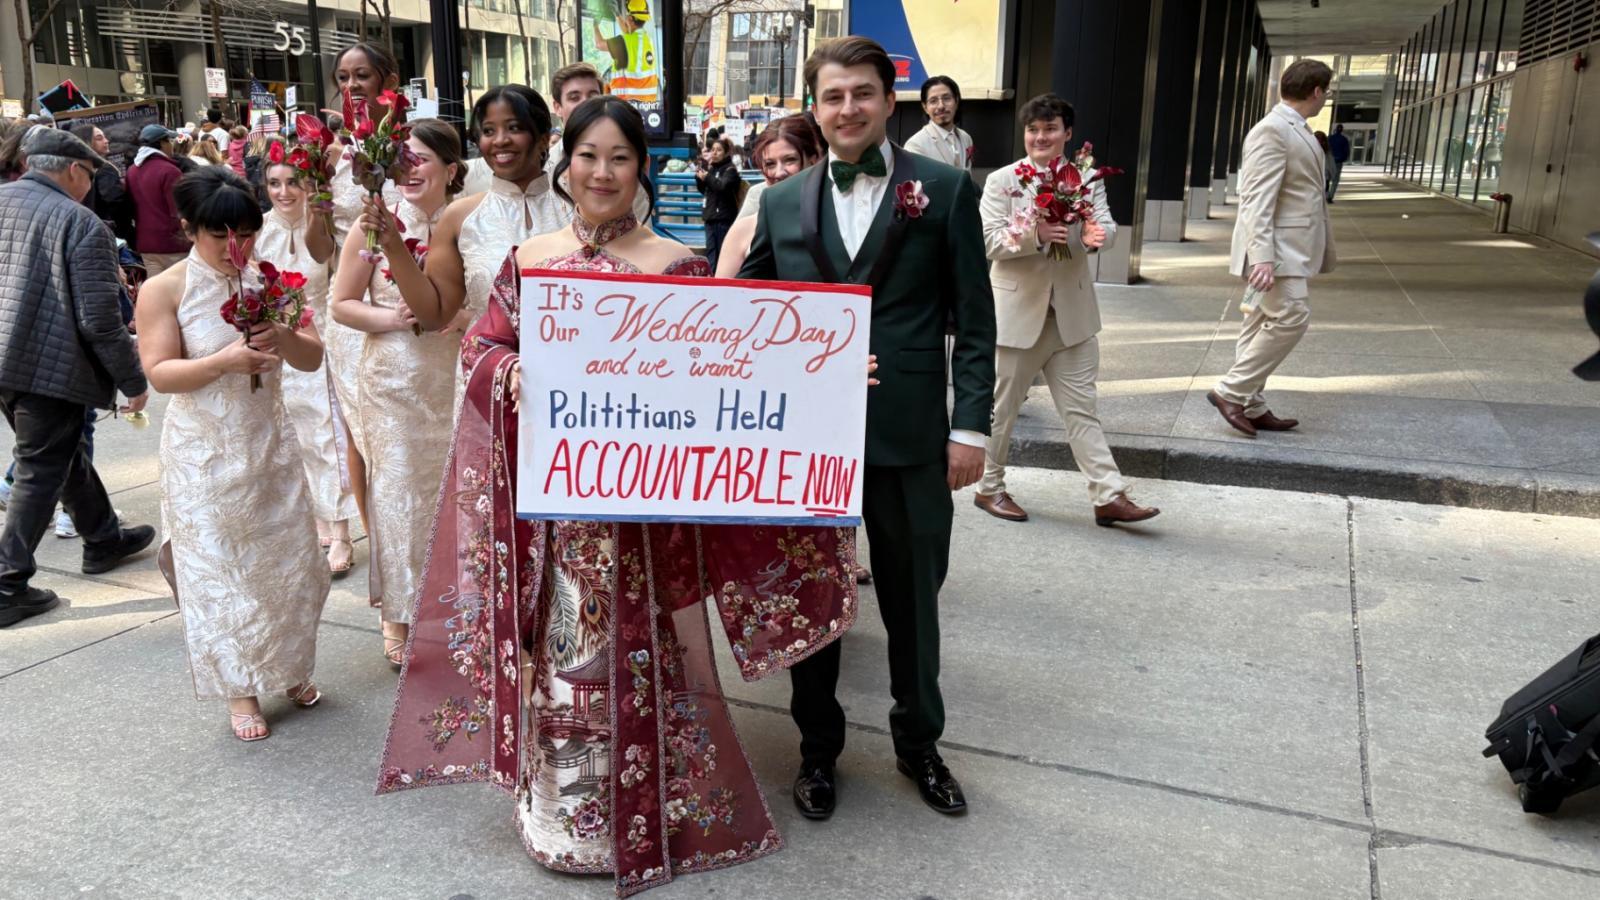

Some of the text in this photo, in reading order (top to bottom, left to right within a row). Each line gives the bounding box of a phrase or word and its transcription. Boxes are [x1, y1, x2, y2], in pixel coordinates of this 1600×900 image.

[274, 21, 306, 56] 55
[537, 283, 583, 311] It's
[540, 292, 856, 373] Our Wedding Day
[585, 347, 753, 379] and we want
[549, 387, 787, 432] Polititians Held
[543, 437, 857, 509] ACCOUNTABLE NOW
